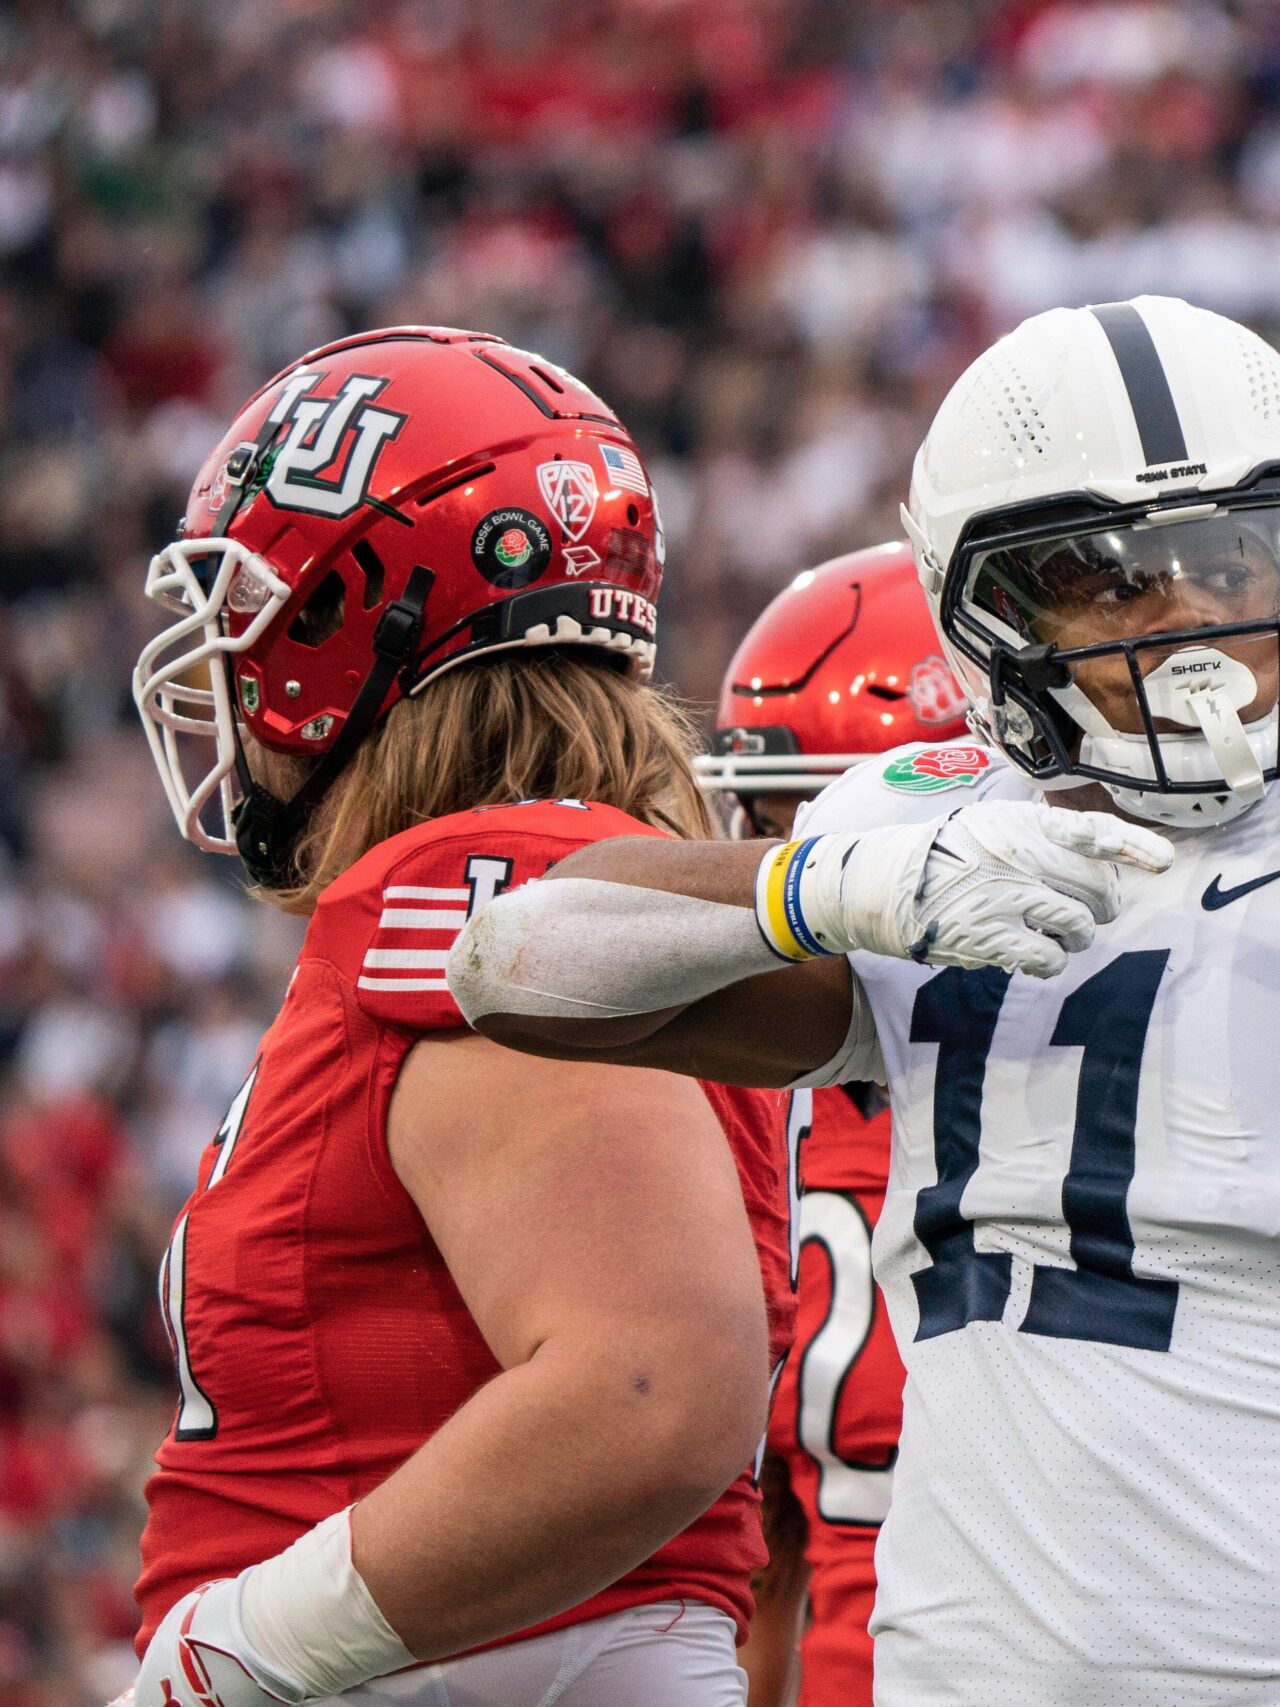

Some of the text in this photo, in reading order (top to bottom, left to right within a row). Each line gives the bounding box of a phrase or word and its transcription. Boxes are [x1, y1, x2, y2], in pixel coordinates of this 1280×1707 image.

[543, 464, 593, 508] PAC
[1136, 463, 1207, 483] PENN STATE
[560, 494, 587, 522] 12
[475, 511, 549, 554] ROSE BOWL GAME
[589, 588, 657, 635] UTES
[1171, 661, 1221, 675] SHOCK
[909, 948, 1179, 1352] 11
